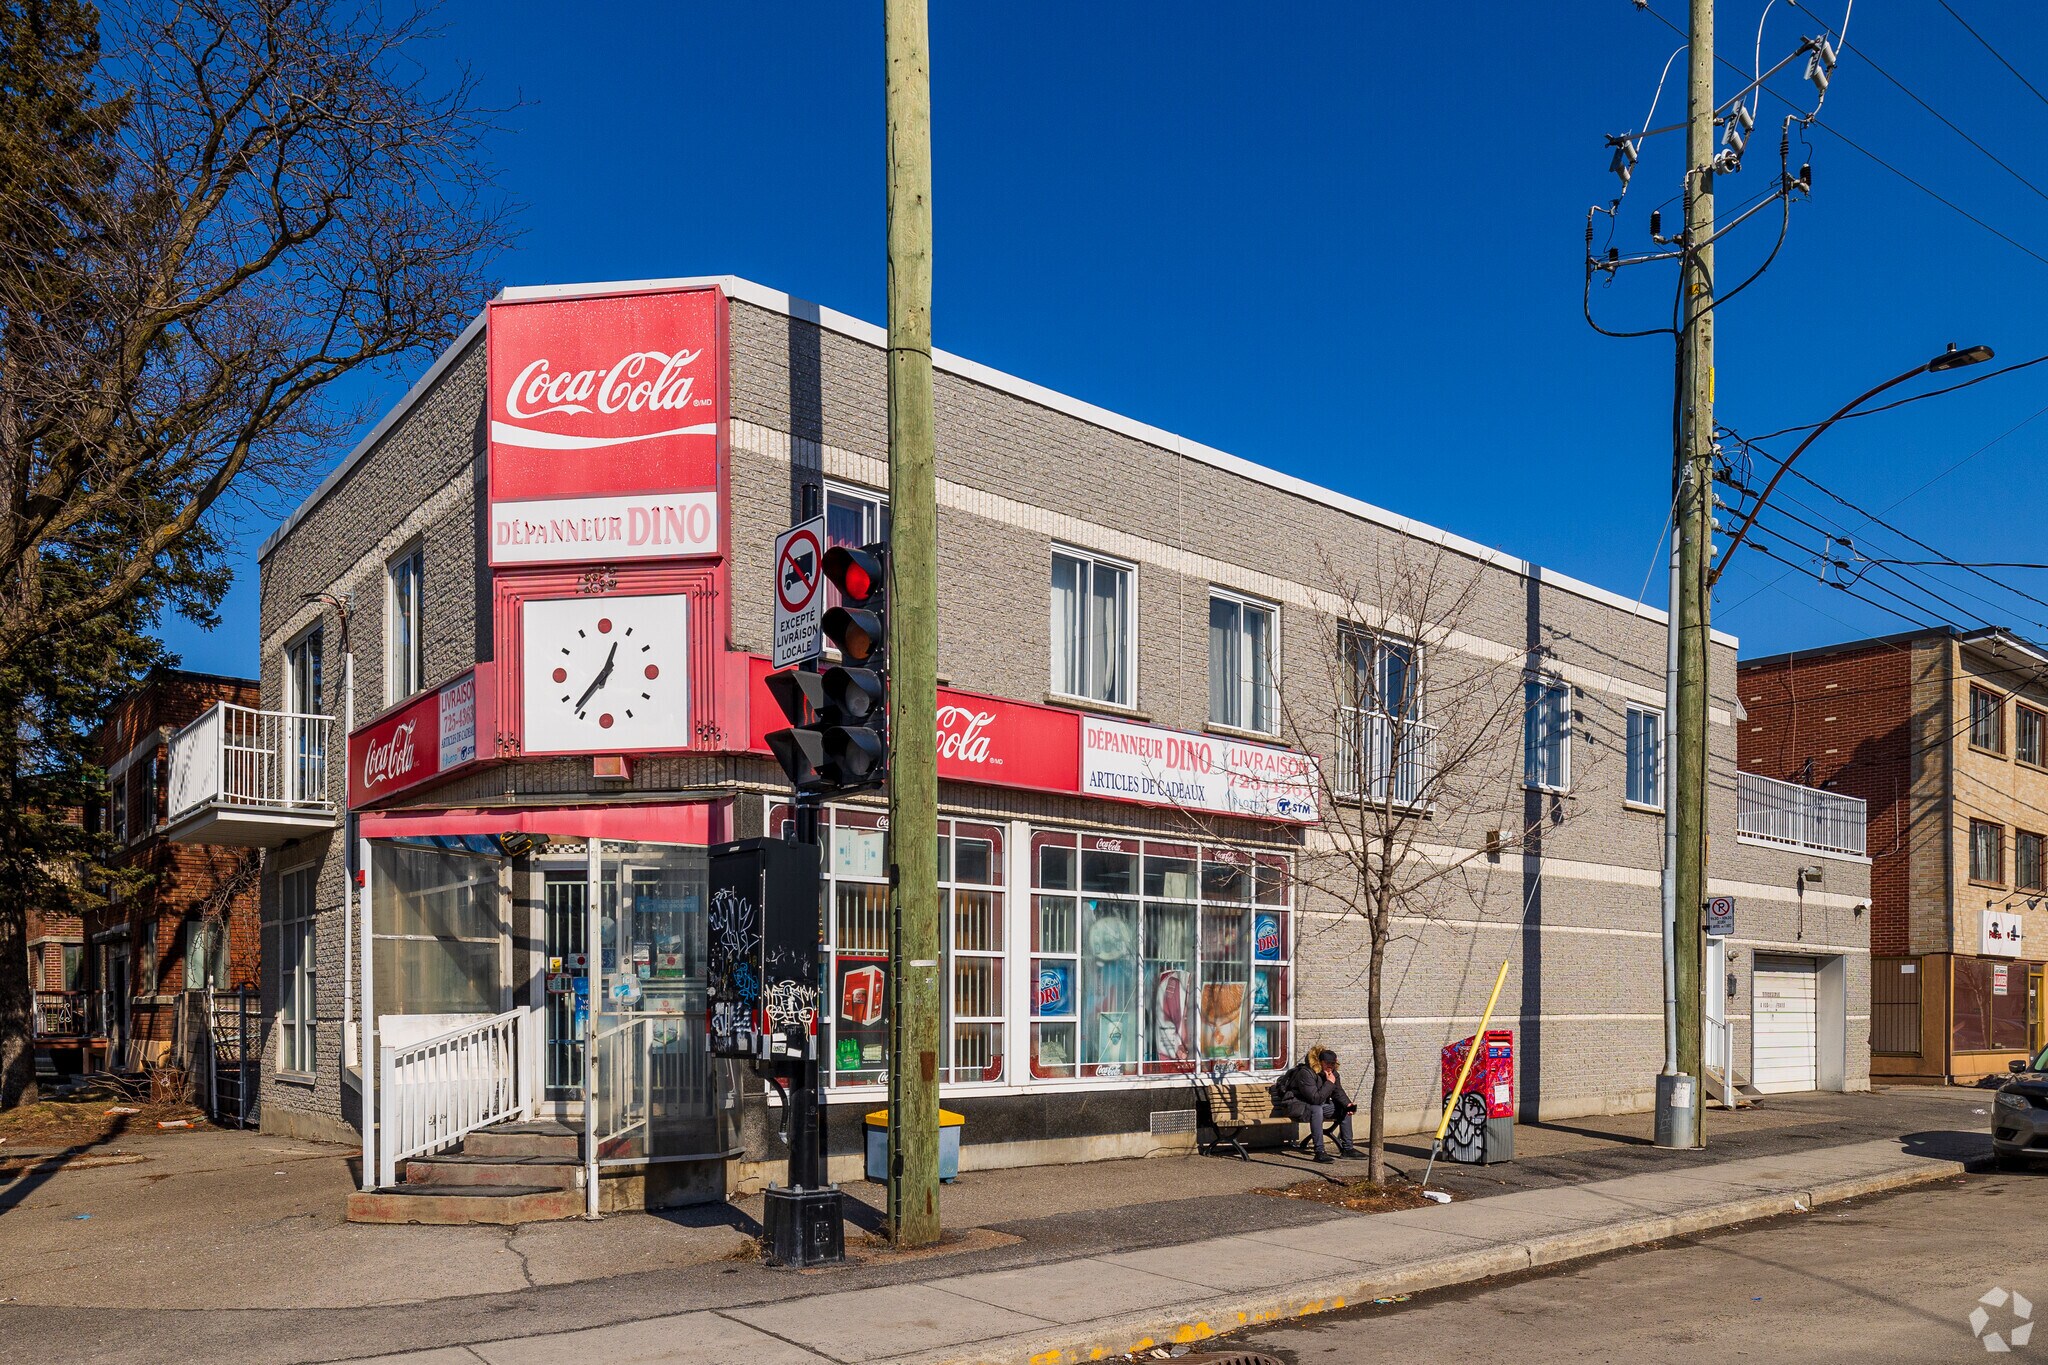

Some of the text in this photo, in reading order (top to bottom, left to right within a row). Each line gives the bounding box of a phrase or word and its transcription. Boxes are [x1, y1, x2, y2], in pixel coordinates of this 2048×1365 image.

[506, 348, 702, 419] Coca-Cola
[497, 503, 711, 547] DÉPANNEUR DINO
[780, 607, 816, 632] EXCEPTÉ
[776, 623, 818, 648] LIVRAISON
[781, 640, 812, 660] LOCALE
[364, 717, 417, 789] Coca-Cola
[1087, 728, 1309, 775] DÉPANNEUR DINO LIVRAISON
[1089, 770, 1206, 801] ARTICLES DE CADEAUX
[1292, 803, 1311, 814] STM
[1258, 934, 1279, 952] DRY
